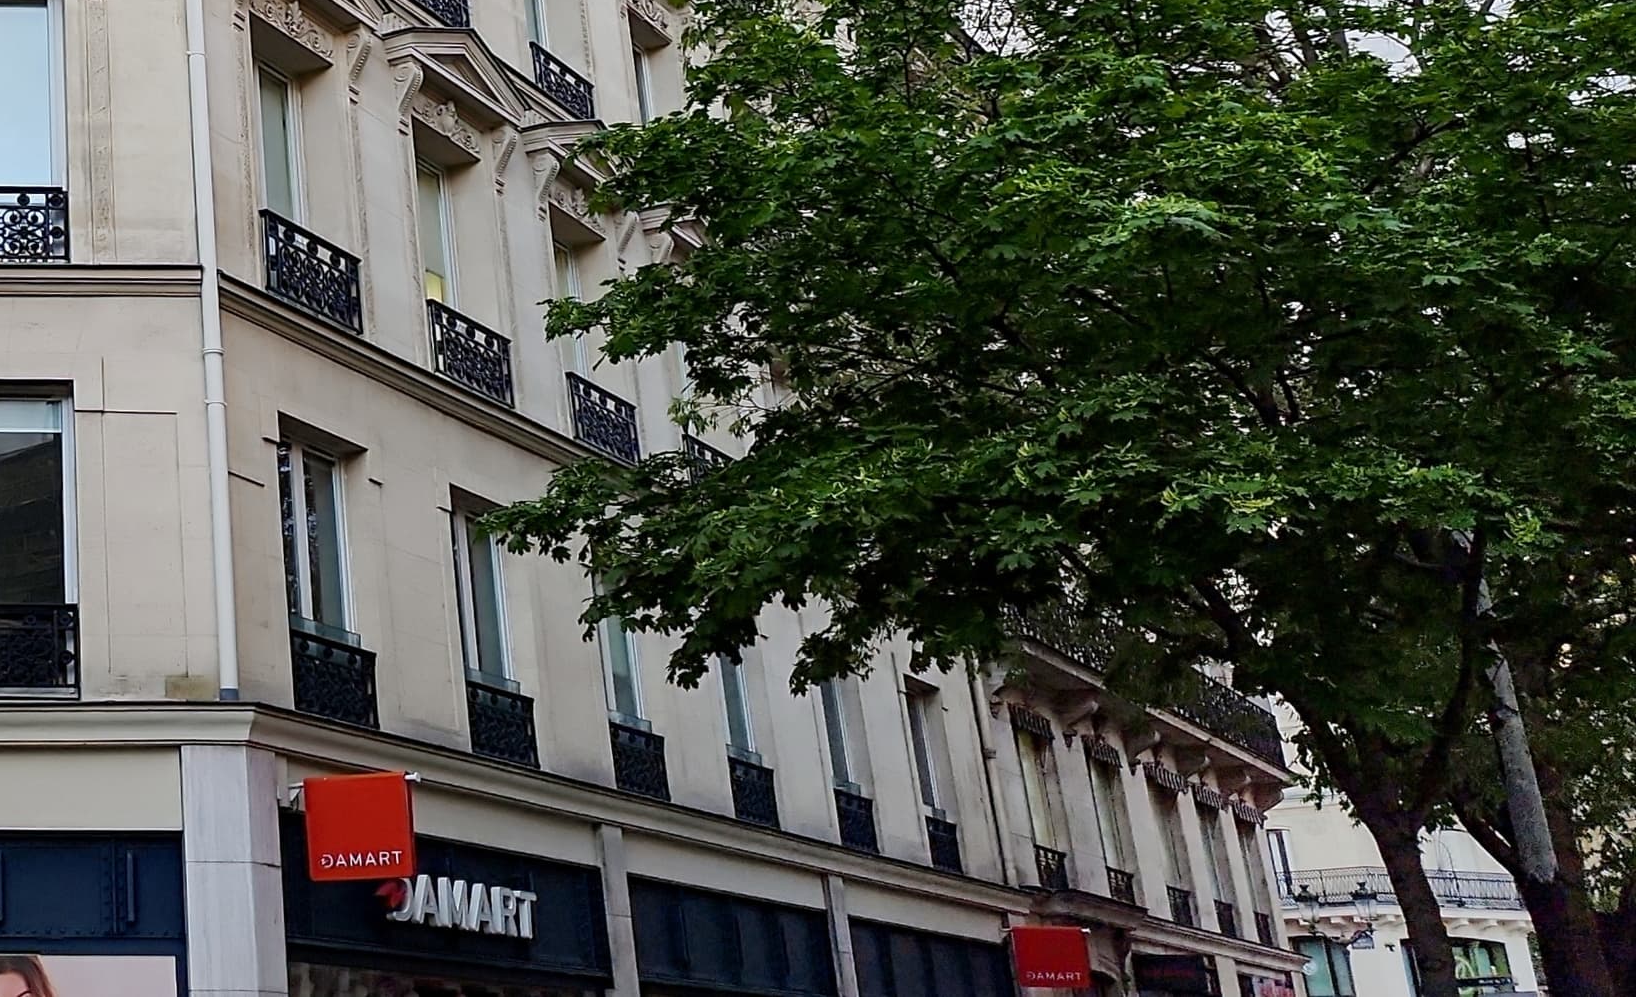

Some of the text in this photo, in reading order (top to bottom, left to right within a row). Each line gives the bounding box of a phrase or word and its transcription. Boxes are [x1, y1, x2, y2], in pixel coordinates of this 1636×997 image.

[320, 850, 403, 869] DAMART
[377, 873, 538, 940] DAMART
[1026, 970, 1082, 981] DAMART
